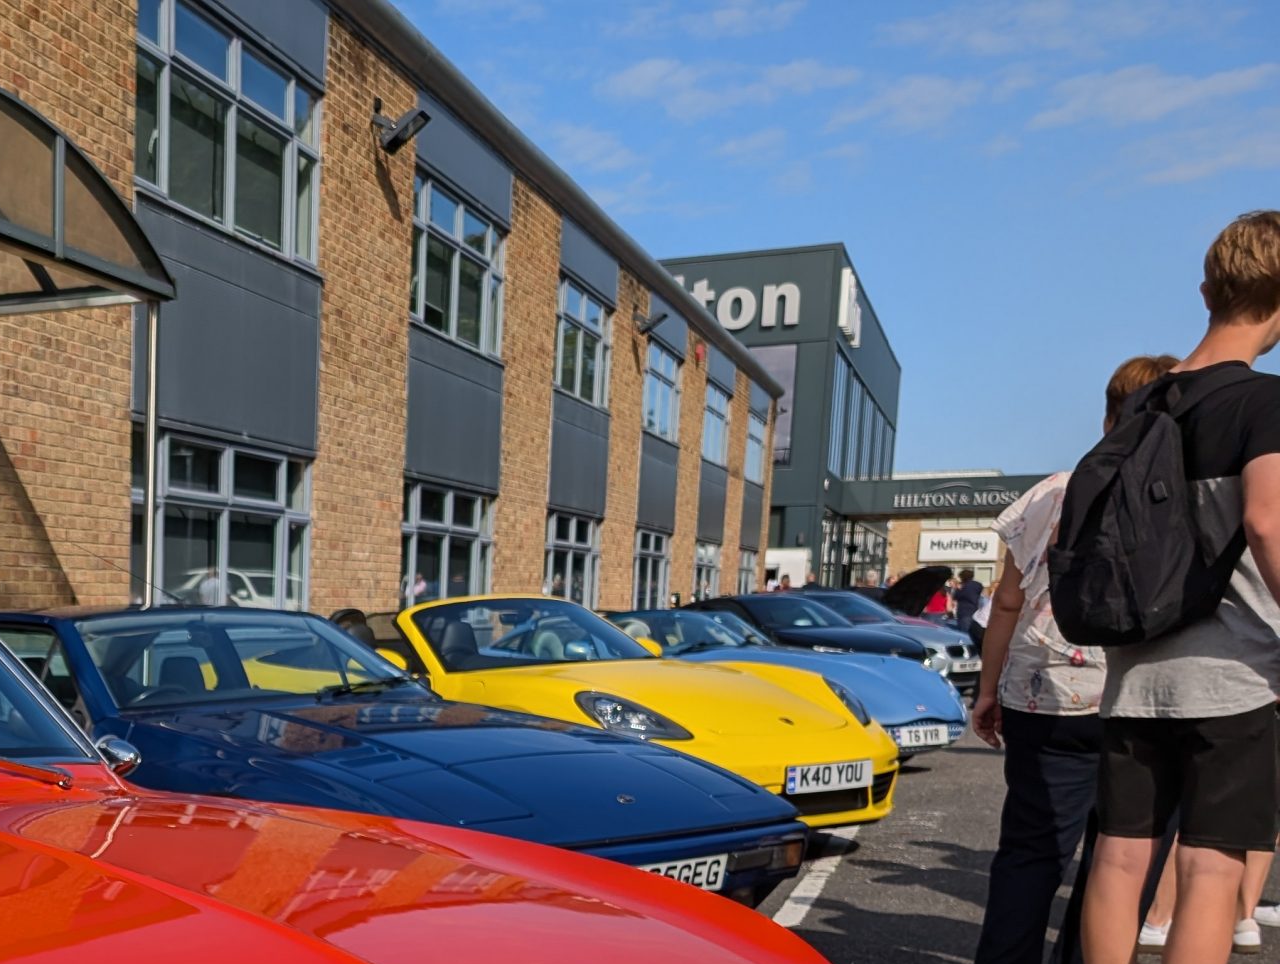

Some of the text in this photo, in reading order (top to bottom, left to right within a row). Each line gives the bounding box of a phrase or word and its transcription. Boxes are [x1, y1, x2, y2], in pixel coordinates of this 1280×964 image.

[673, 274, 801, 331] ton
[893, 490, 1020, 508] HILTON & MOSS
[929, 537, 988, 554] MultiPay
[907, 729, 921, 743] T6
[800, 766, 832, 787] K40
[837, 763, 863, 784] YOU
